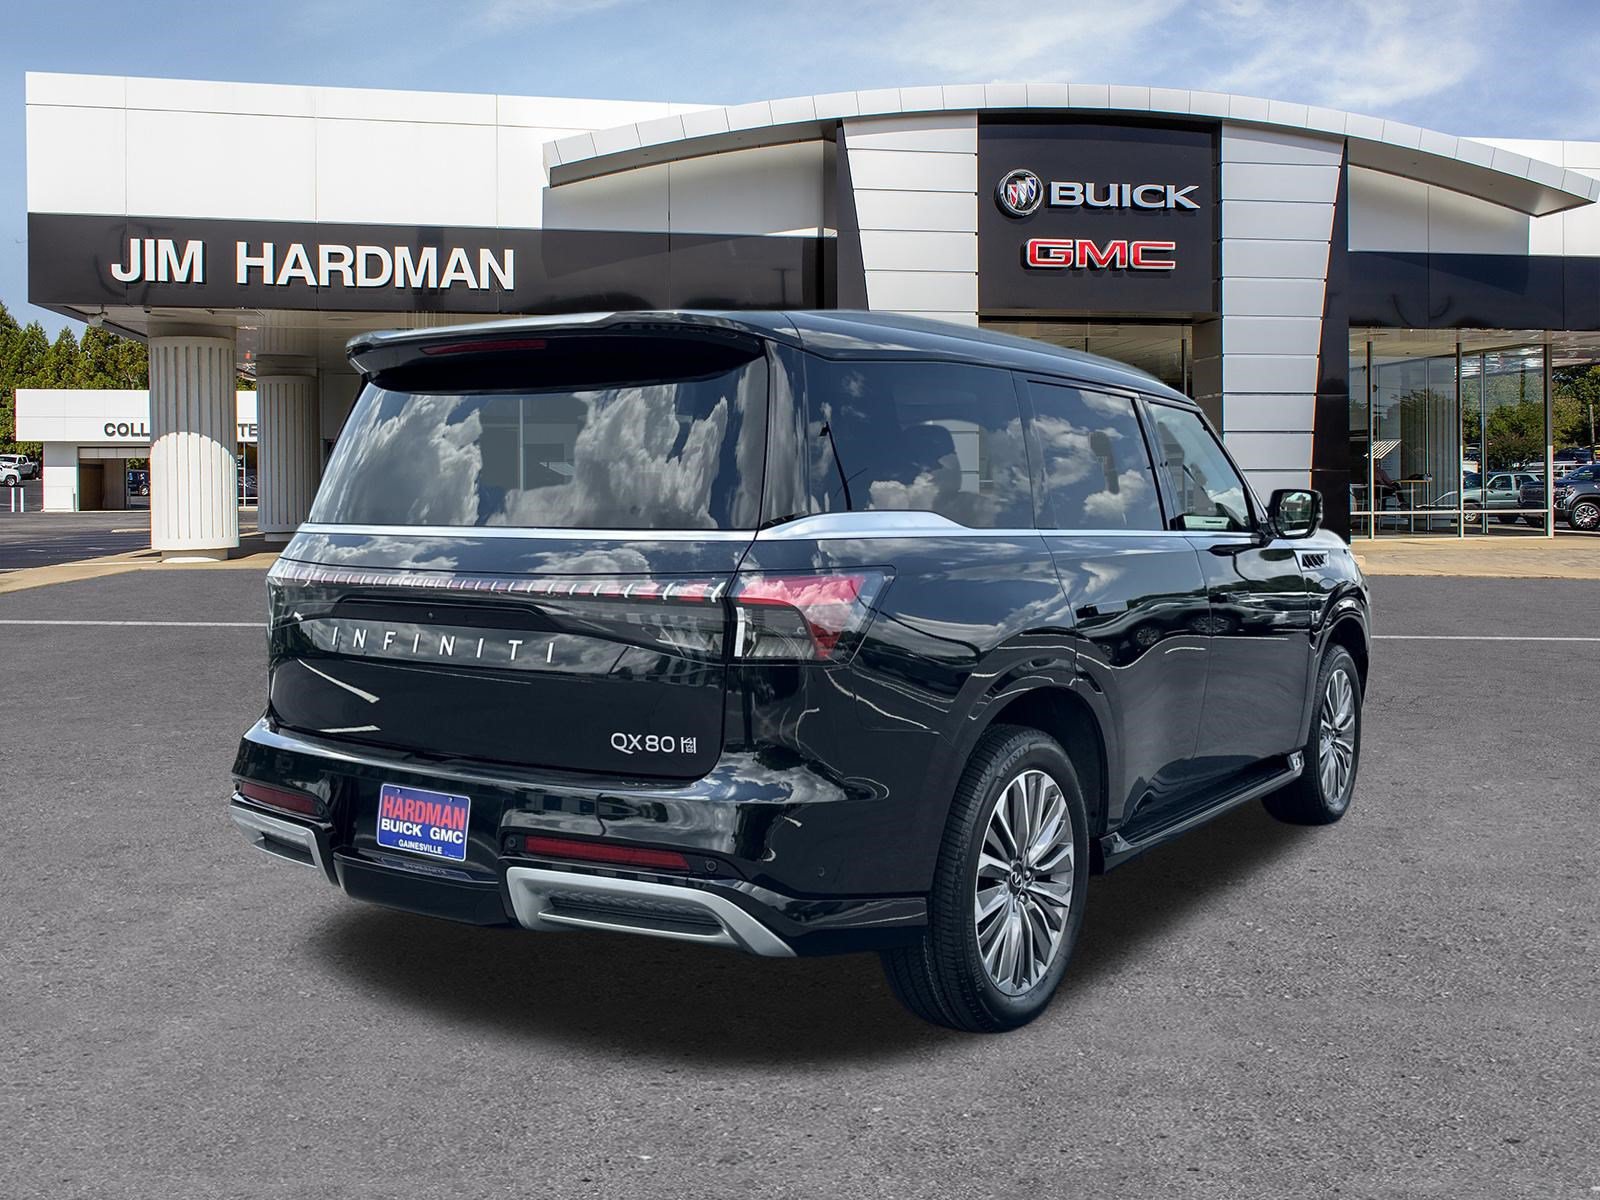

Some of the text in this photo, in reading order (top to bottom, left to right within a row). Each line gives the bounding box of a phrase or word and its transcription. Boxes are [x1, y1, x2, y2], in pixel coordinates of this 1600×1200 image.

[1050, 181, 1200, 209] BUICK
[111, 238, 515, 291] JIM HARDMAN
[1026, 238, 1176, 270] GMC
[104, 422, 150, 437] COLL
[331, 626, 555, 663] INFINITI
[610, 732, 675, 754] QX80
[382, 795, 465, 830] HARDMAN
[381, 818, 464, 844] BUICK GMC
[398, 839, 443, 854] GAINESVILLE
